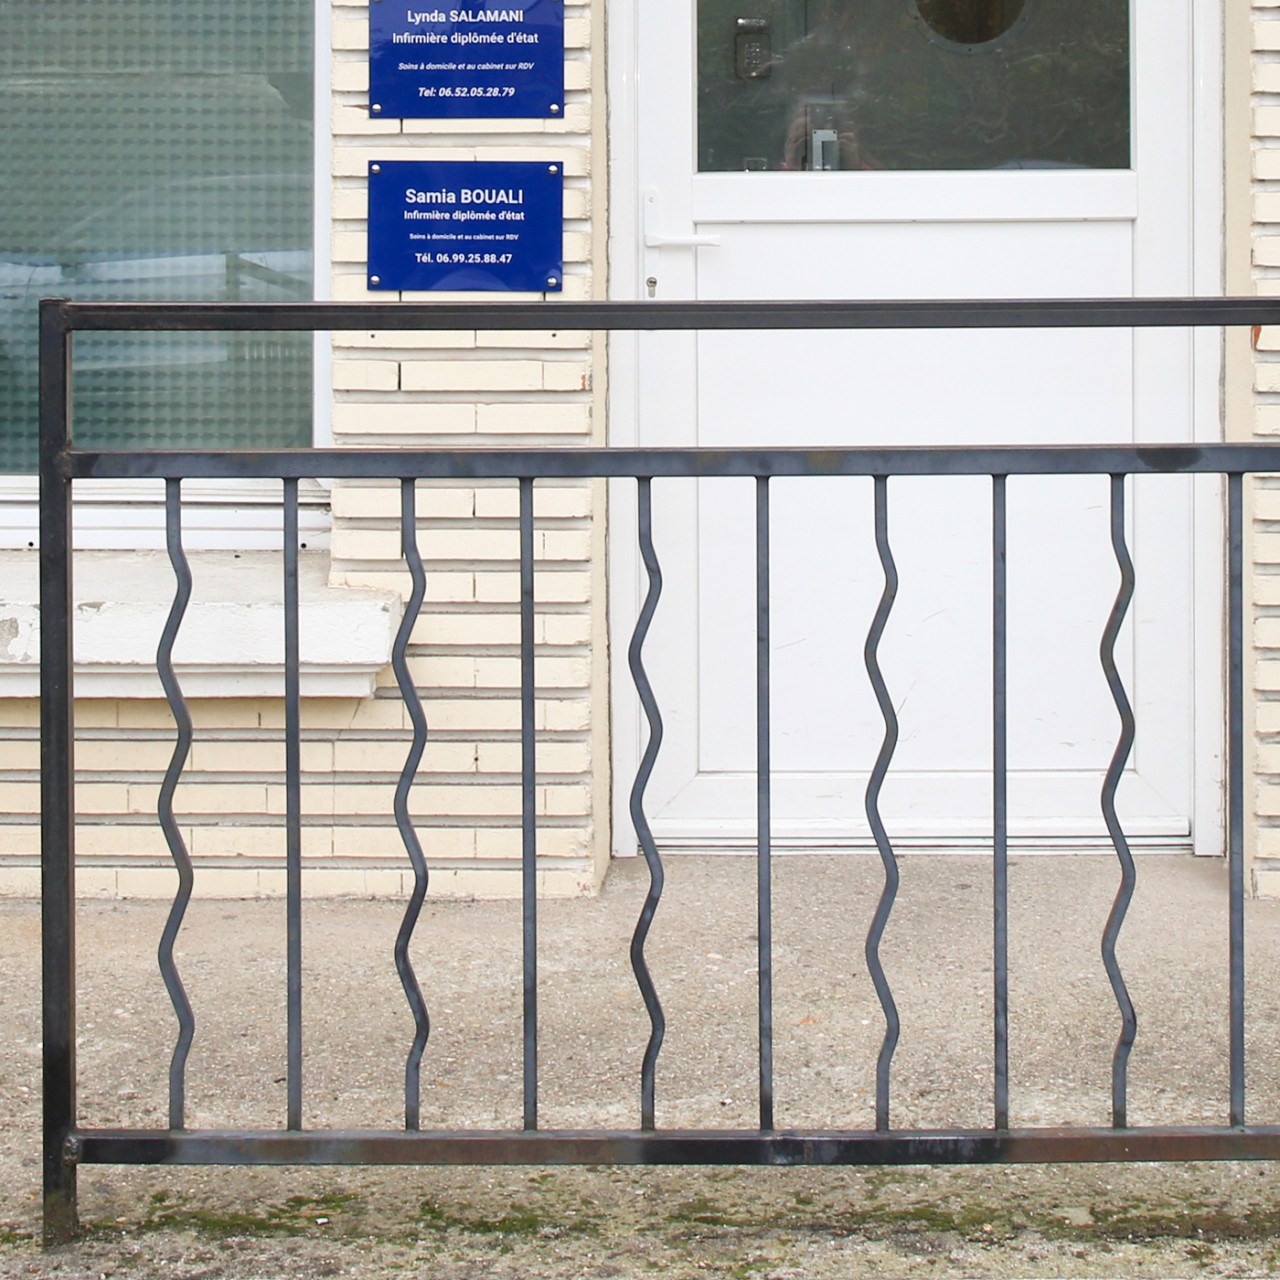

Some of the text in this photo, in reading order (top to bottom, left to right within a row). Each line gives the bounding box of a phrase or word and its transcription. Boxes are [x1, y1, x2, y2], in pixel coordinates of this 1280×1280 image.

[407, 9, 524, 26] Lynda SALAMANI
[392, 31, 540, 46] Infirmière diplômée d'état
[397, 61, 536, 71] Soins à domicile et au cabinet sur RDV
[417, 86, 516, 98] Tel: 06.52.05.28.79
[404, 187, 524, 205] Samia BOUALI
[403, 209, 526, 223] Infirmière diplômée d'état
[408, 232, 427, 241] Soins
[426, 232, 432, 241] à
[431, 232, 457, 241] domicile
[457, 232, 464, 241] et
[472, 232, 495, 241] cabinet
[505, 232, 520, 241] RDV
[414, 252, 513, 264] Tél. 06.99.25.88.47
